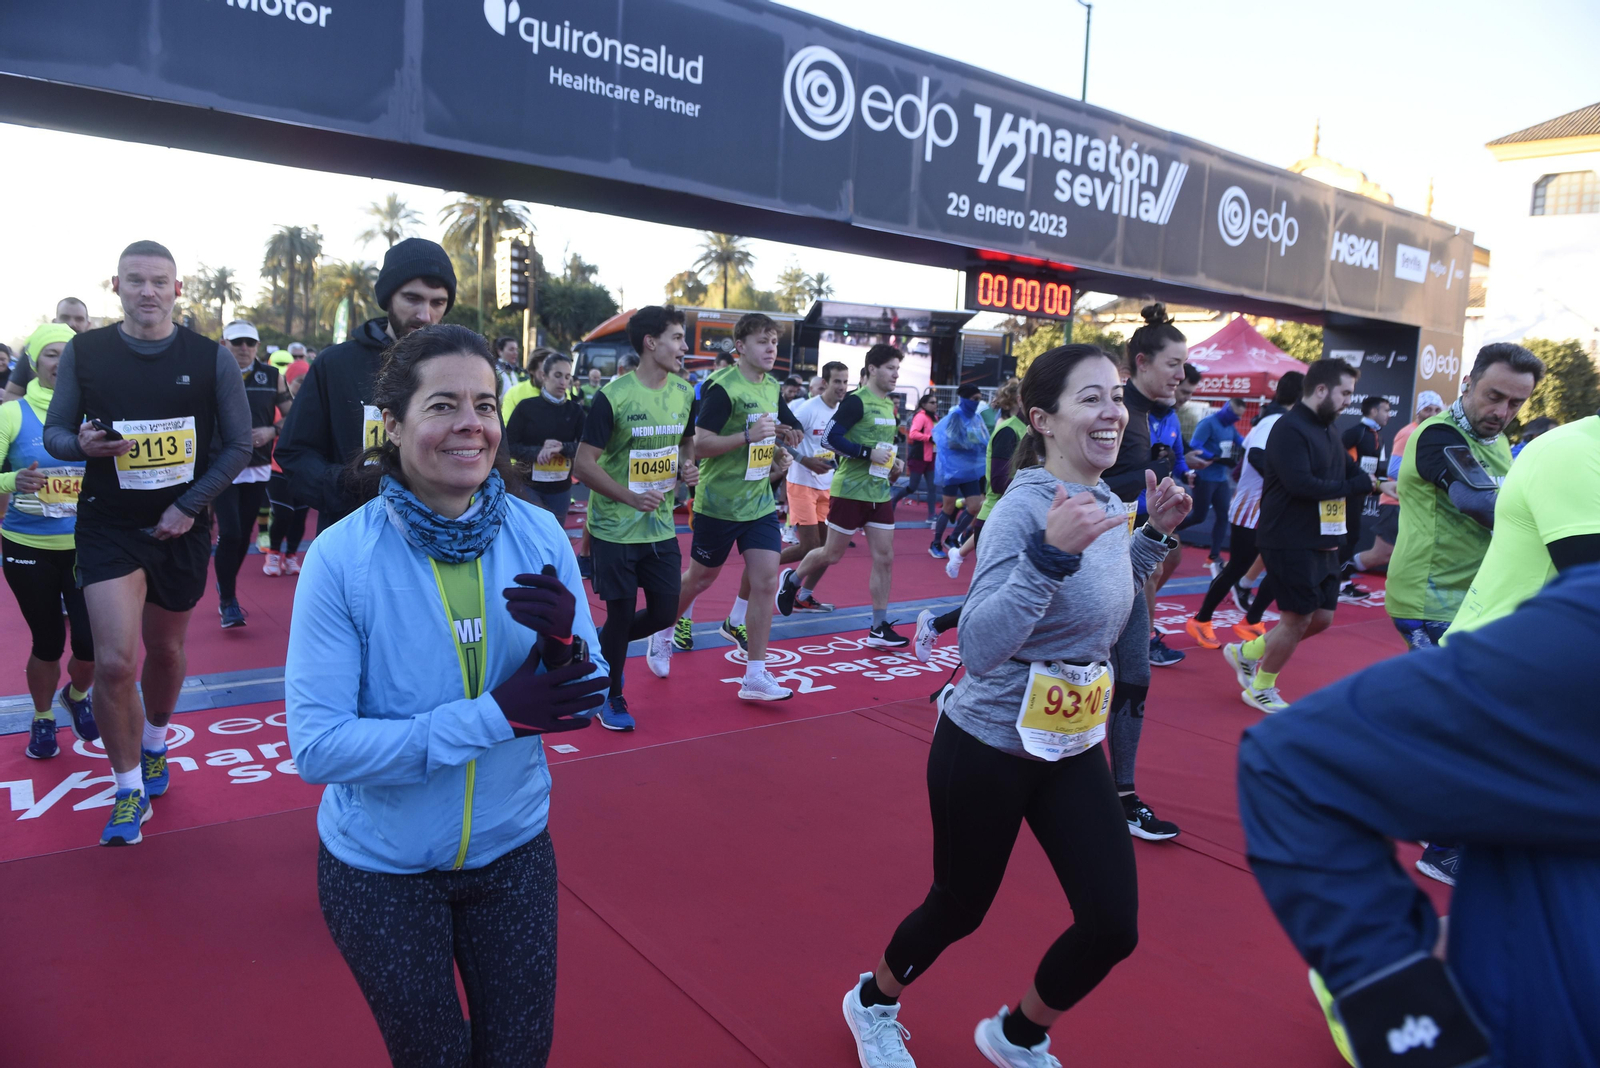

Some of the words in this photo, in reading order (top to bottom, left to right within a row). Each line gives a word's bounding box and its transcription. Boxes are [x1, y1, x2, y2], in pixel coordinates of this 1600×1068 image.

[518, 16, 703, 85] quirónsalud
[550, 65, 640, 104] Healthcare
[644, 88, 701, 118] Partner
[860, 76, 959, 162] edp
[1018, 116, 1159, 187] maratón
[947, 192, 970, 218] 29
[974, 202, 1025, 229] enero
[1029, 210, 1068, 238] 2023
[1252, 200, 1299, 257] edp
[1330, 230, 1379, 271] HOKA
[978, 271, 1008, 308] 00
[1011, 277, 1040, 312] 00
[1043, 282, 1071, 316] 00
[1436, 348, 1460, 381] edp
[627, 413, 648, 422] HOKA
[632, 426, 655, 437] MEDIO
[128, 436, 178, 459] 9113
[634, 458, 671, 475] 10490
[1044, 685, 1102, 718] 9310
